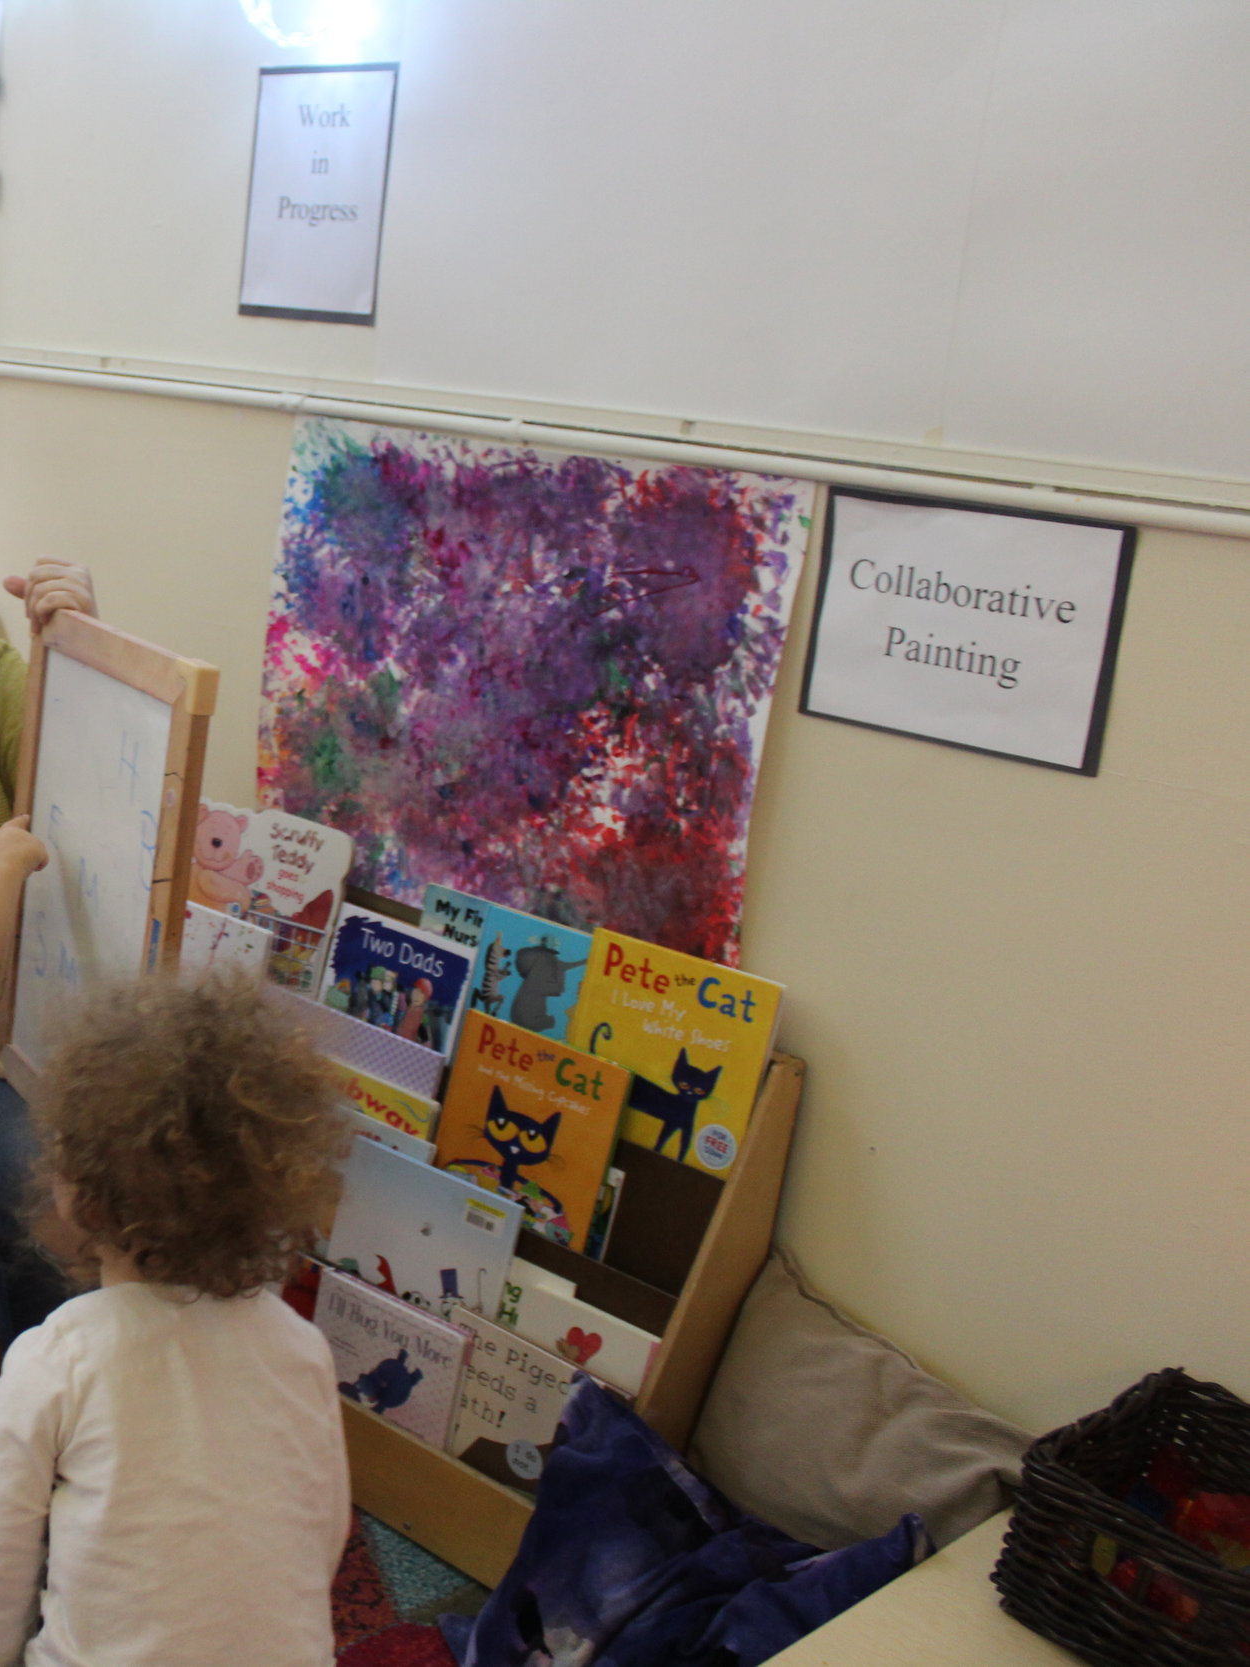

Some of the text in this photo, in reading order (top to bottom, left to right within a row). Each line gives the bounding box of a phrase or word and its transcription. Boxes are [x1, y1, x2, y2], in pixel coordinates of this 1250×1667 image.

[299, 104, 351, 127] Work
[310, 151, 329, 174] in
[277, 197, 359, 227] Progress
[849, 558, 1076, 624] Collaborative
[883, 625, 1021, 690] Painting
[269, 822, 325, 852] Scruffy
[272, 844, 315, 875] Teddy
[278, 868, 300, 882] goes
[266, 880, 305, 904] shopping
[435, 899, 484, 929] My Fir
[442, 923, 479, 948] Nurs
[360, 927, 445, 978] Two Dads
[603, 942, 757, 1024] Pete the Cat
[622, 991, 656, 1013] Love
[660, 999, 688, 1023] My
[642, 1018, 733, 1053] White Shoes
[477, 1022, 605, 1101] Pete the Cat
[383, 1321, 410, 1350] You
[416, 1335, 453, 1368] More
[505, 1347, 569, 1396] Pigeo
[465, 1364, 538, 1414] eeds a
[460, 1393, 506, 1428] ath!
